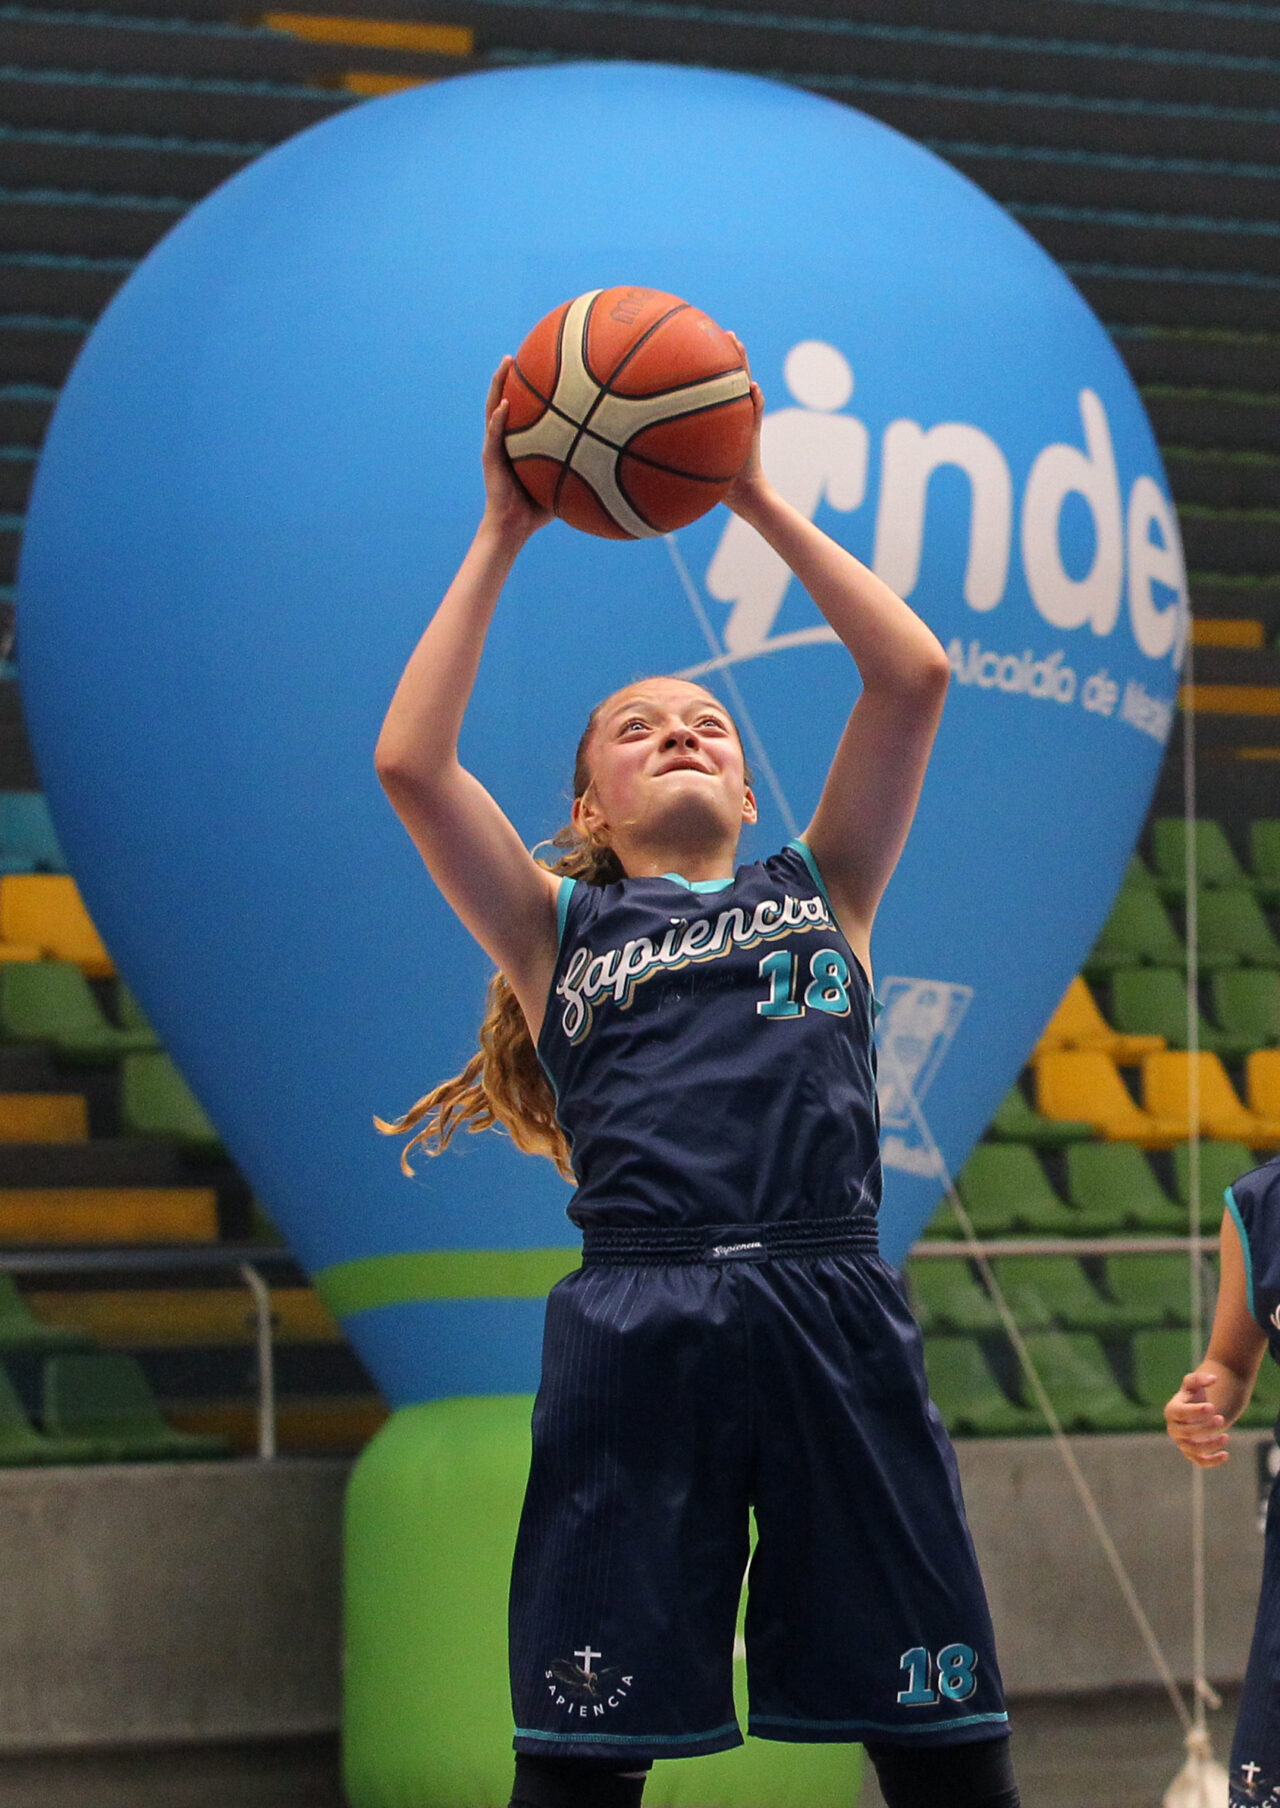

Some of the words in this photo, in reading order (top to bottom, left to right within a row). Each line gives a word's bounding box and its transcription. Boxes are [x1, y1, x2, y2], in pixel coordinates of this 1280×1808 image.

[706, 340, 1184, 670] inde
[556, 894, 836, 1045] Sapiencia
[756, 948, 852, 1020] 18
[543, 1669, 634, 1717] SAPIENCIA
[897, 1642, 979, 1707] 18
